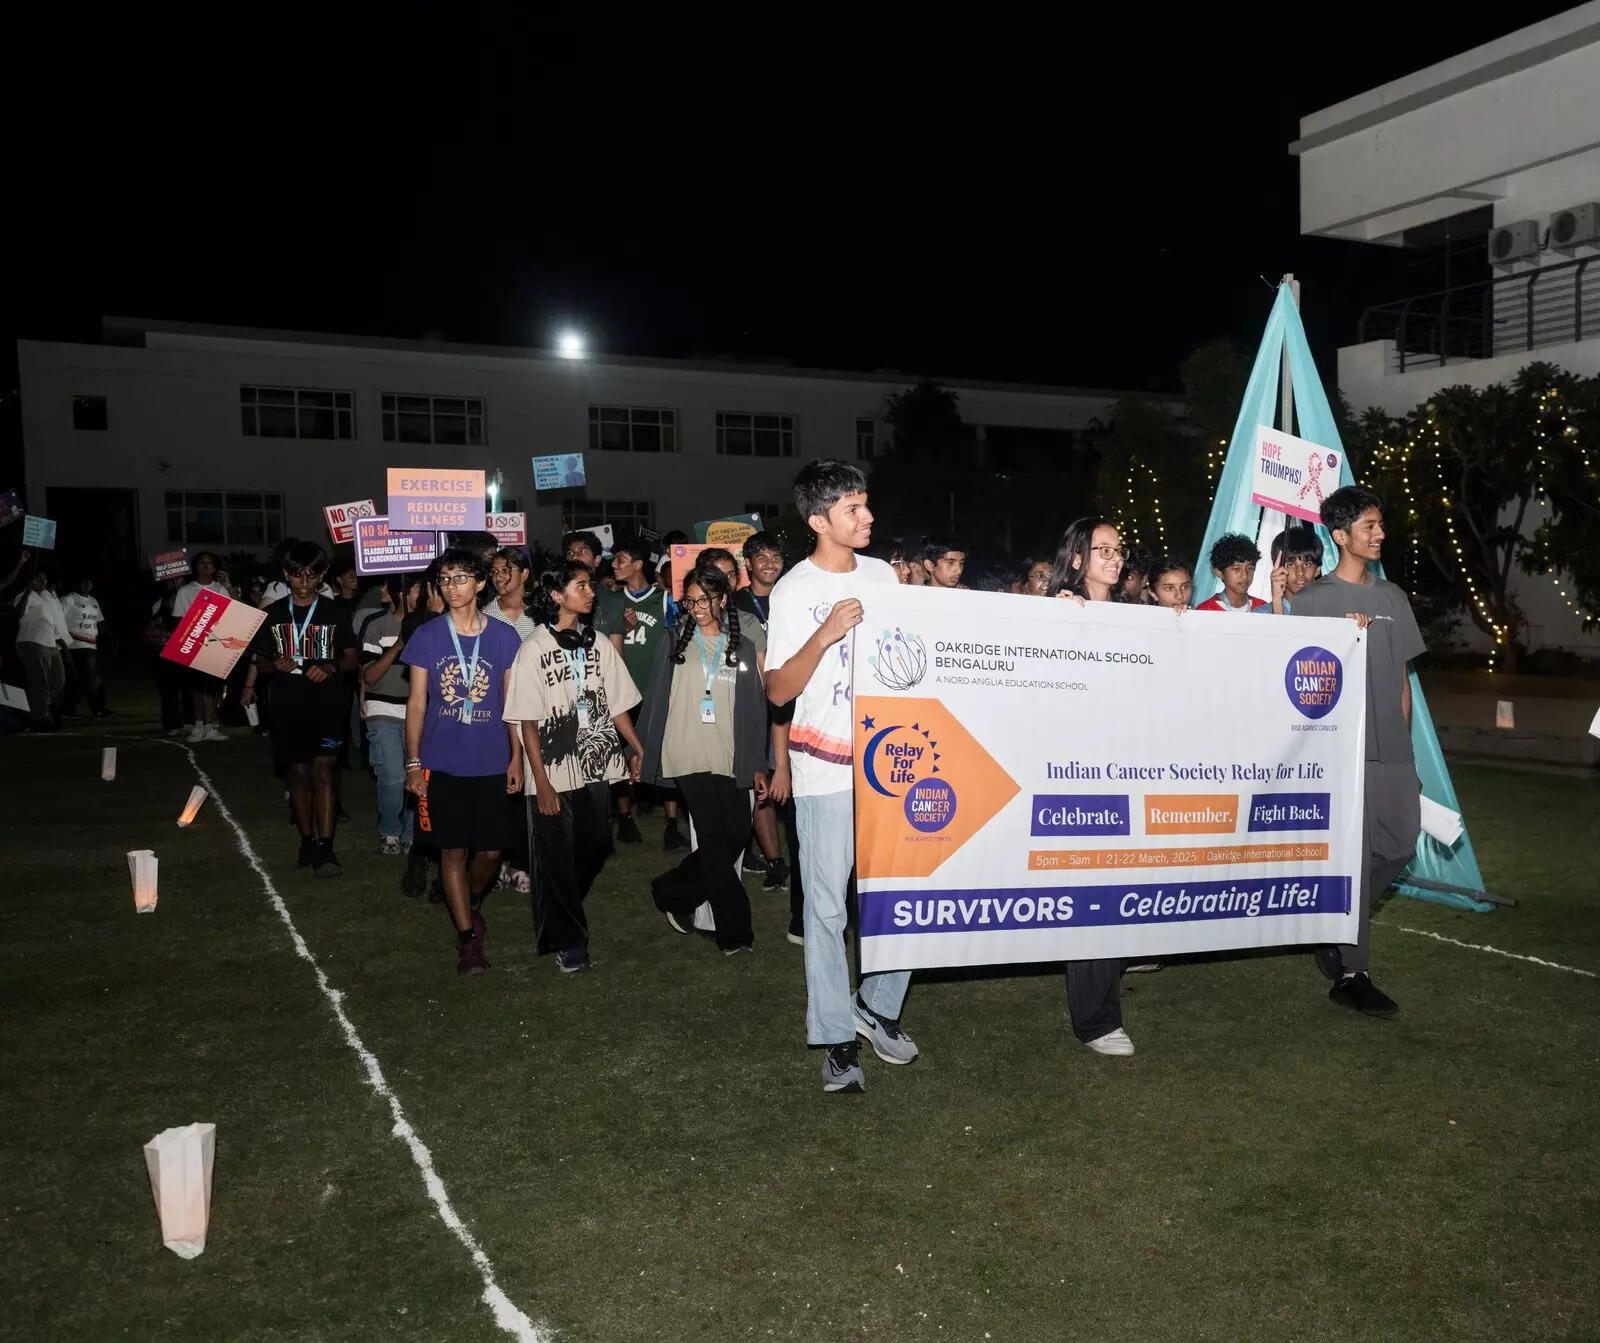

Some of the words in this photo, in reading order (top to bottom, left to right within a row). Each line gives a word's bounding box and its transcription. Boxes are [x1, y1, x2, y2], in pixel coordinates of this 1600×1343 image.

[1262, 441, 1282, 461] HOPE
[1261, 458, 1302, 485] TRIUMPHS!
[401, 480, 472, 492] EXERCISE
[407, 502, 468, 513] REDUCES
[330, 508, 346, 524] NO
[410, 514, 464, 526] ILLNESS
[361, 524, 374, 536] NO
[388, 538, 398, 546] HAS
[400, 538, 412, 546] BEEN
[364, 546, 394, 556] CLASSIFIED
[394, 546, 402, 554] BY
[364, 556, 368, 564] A
[370, 554, 408, 563] CARCINOGENIC
[180, 637, 197, 654] QUIT
[191, 604, 218, 638] SMOKING!
[936, 641, 1001, 656] OAKRIDGE
[1004, 646, 1102, 662] INTERNATIONAL
[1105, 652, 1154, 664] SCHOOL
[936, 656, 1015, 672] BENGALURU
[1296, 660, 1336, 675] INDIAN
[944, 676, 970, 684] NORD
[972, 678, 1004, 686] ANGLIA
[1005, 679, 1054, 688] EDUCATION
[1055, 681, 1088, 690] SCHOOL
[1294, 677, 1336, 692] CANCER
[1300, 692, 1332, 705] SOCIETY
[885, 743, 924, 760] Relay
[894, 756, 914, 769] For
[890, 769, 916, 784] Life
[1047, 761, 1101, 780] Indian
[1106, 762, 1165, 780] Cancer
[1170, 762, 1227, 784] Society
[1232, 763, 1274, 784] Relay
[1276, 763, 1294, 780] for
[1298, 762, 1324, 780] Life
[915, 788, 948, 800] INDIAN
[912, 800, 950, 812] CANCER
[914, 812, 947, 822] SOCIETY
[1038, 807, 1124, 826] Celebrate.
[1150, 806, 1232, 824] Remember.
[1254, 805, 1286, 824] Fight
[1290, 804, 1324, 820] Back.
[1036, 855, 1058, 866] 5pm
[1069, 854, 1090, 865] 5am
[1106, 854, 1136, 864] 21-22
[1138, 853, 1169, 864] March,
[1172, 852, 1197, 863] 2025
[1207, 850, 1241, 862] Oakridge
[1243, 848, 1294, 858] International
[1295, 847, 1322, 857] School
[893, 896, 1074, 926] SURVIVORS
[1119, 886, 1264, 918] Celebrating
[1268, 884, 1318, 909] Life!
